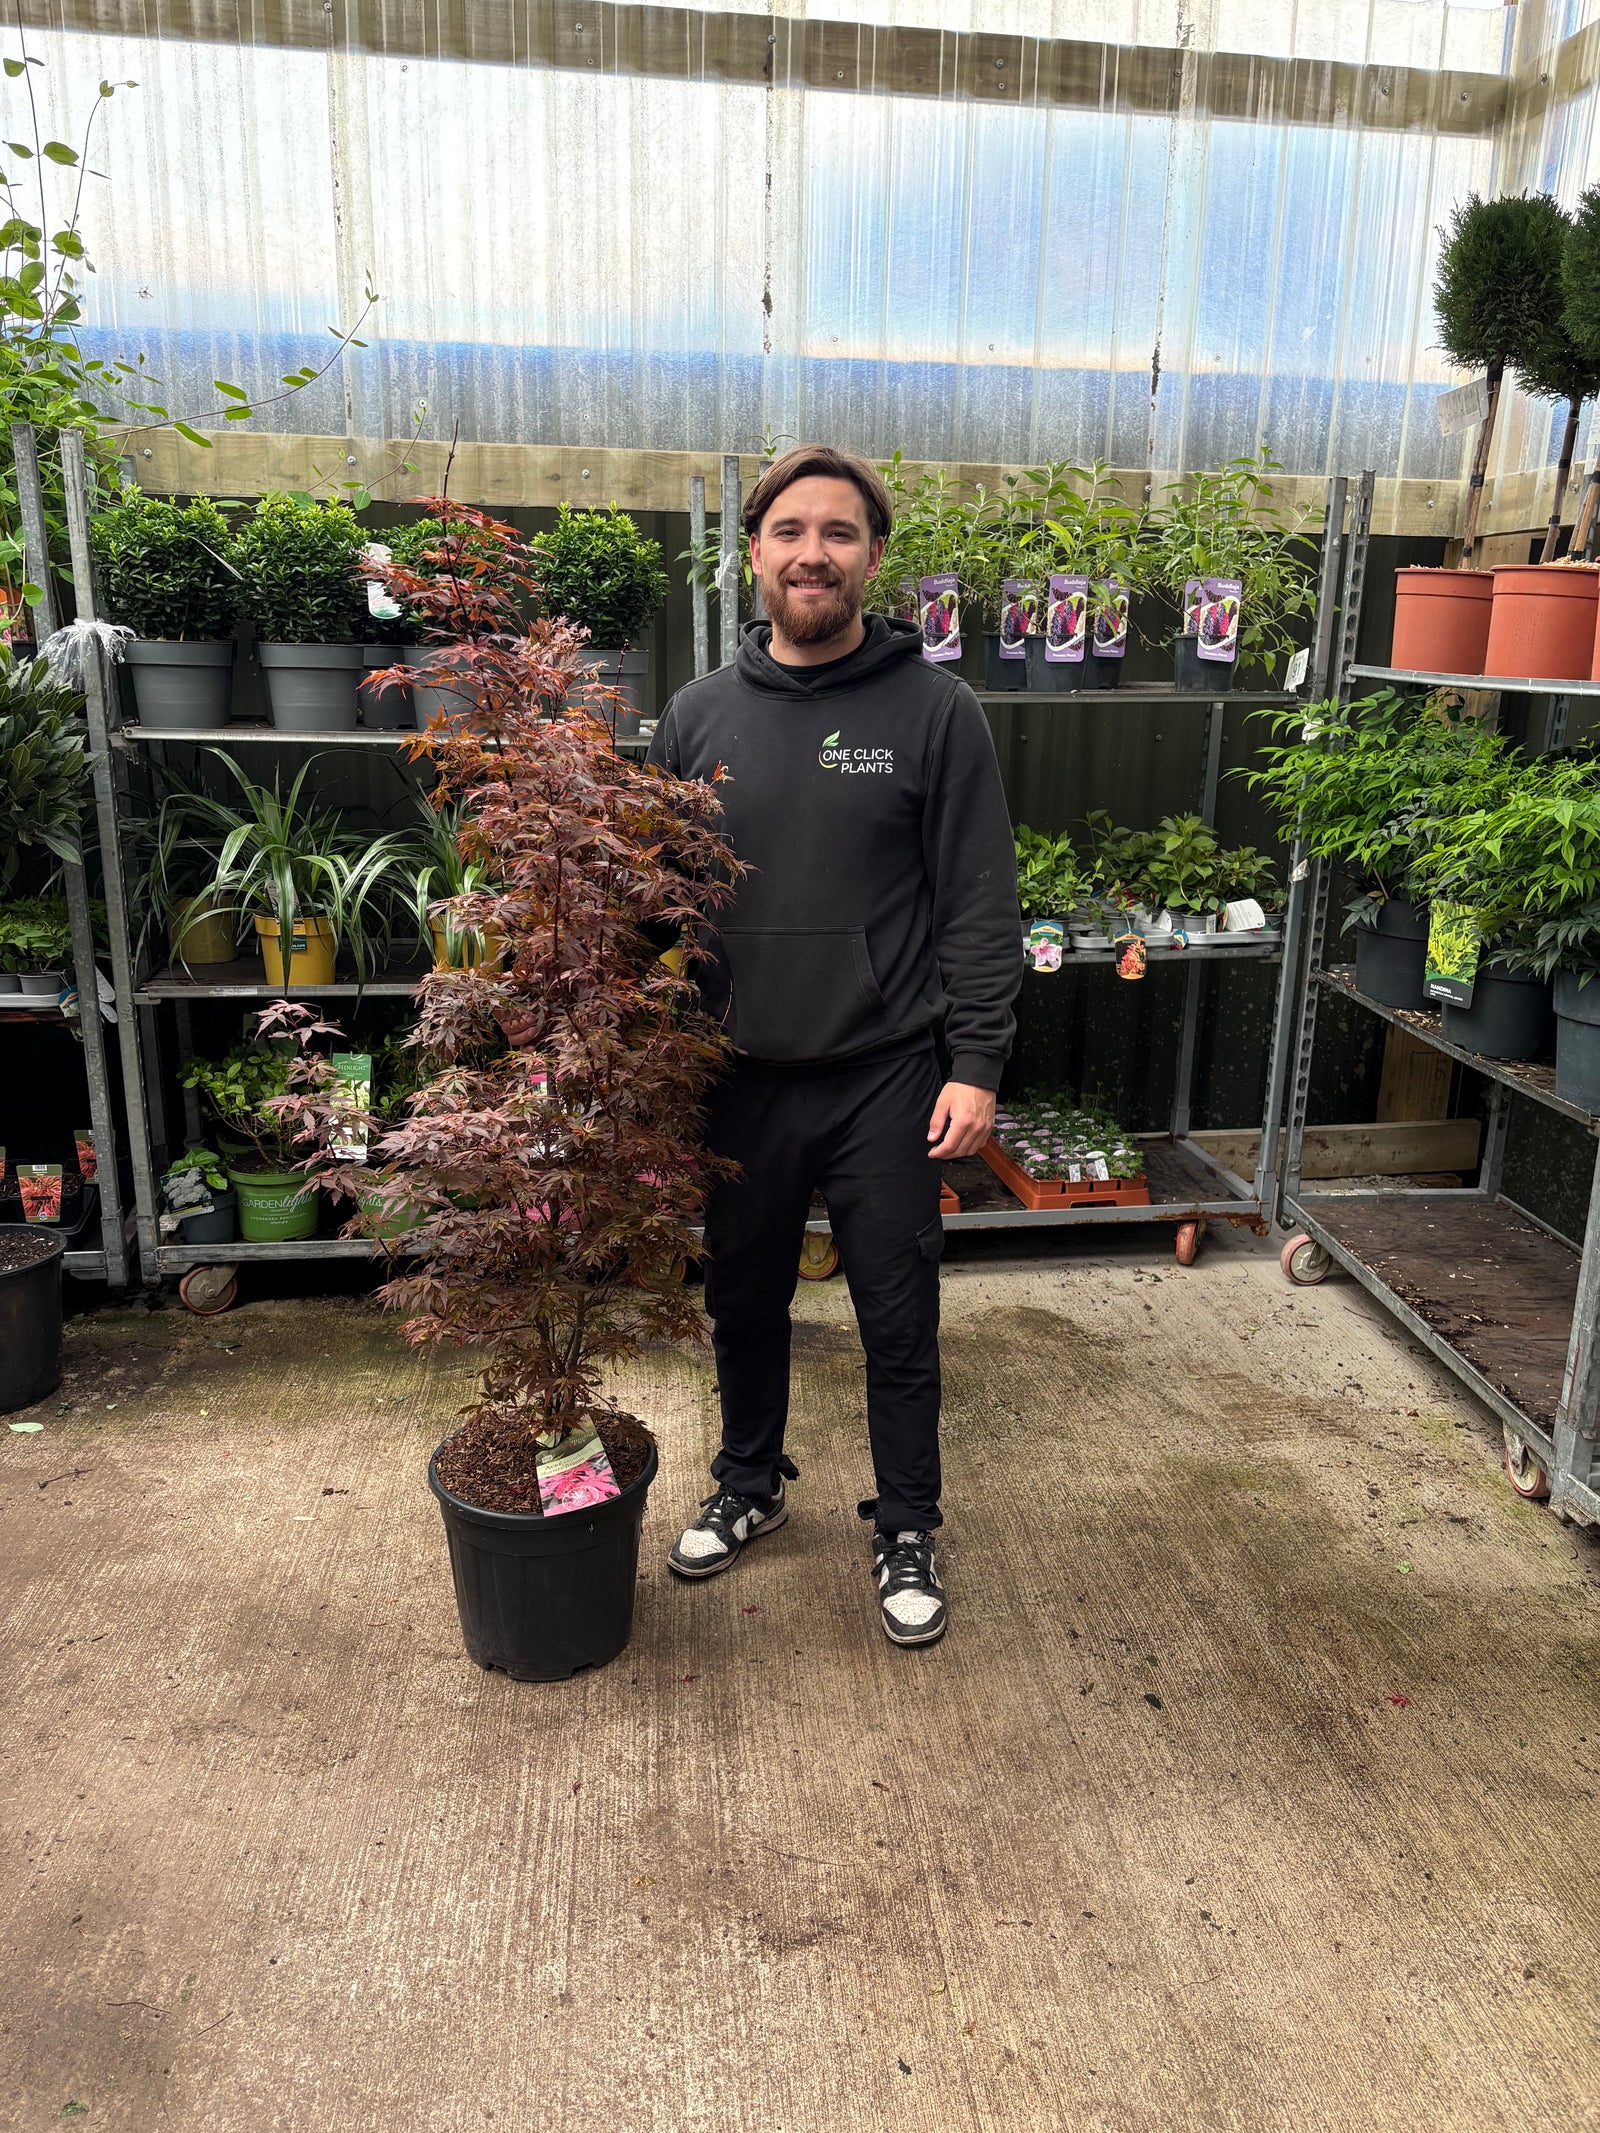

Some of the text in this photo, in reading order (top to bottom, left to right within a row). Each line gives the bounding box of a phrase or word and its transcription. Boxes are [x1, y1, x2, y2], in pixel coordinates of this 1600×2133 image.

[822, 748, 894, 761] ONE CLICK
[841, 762, 894, 774] PLANTS
